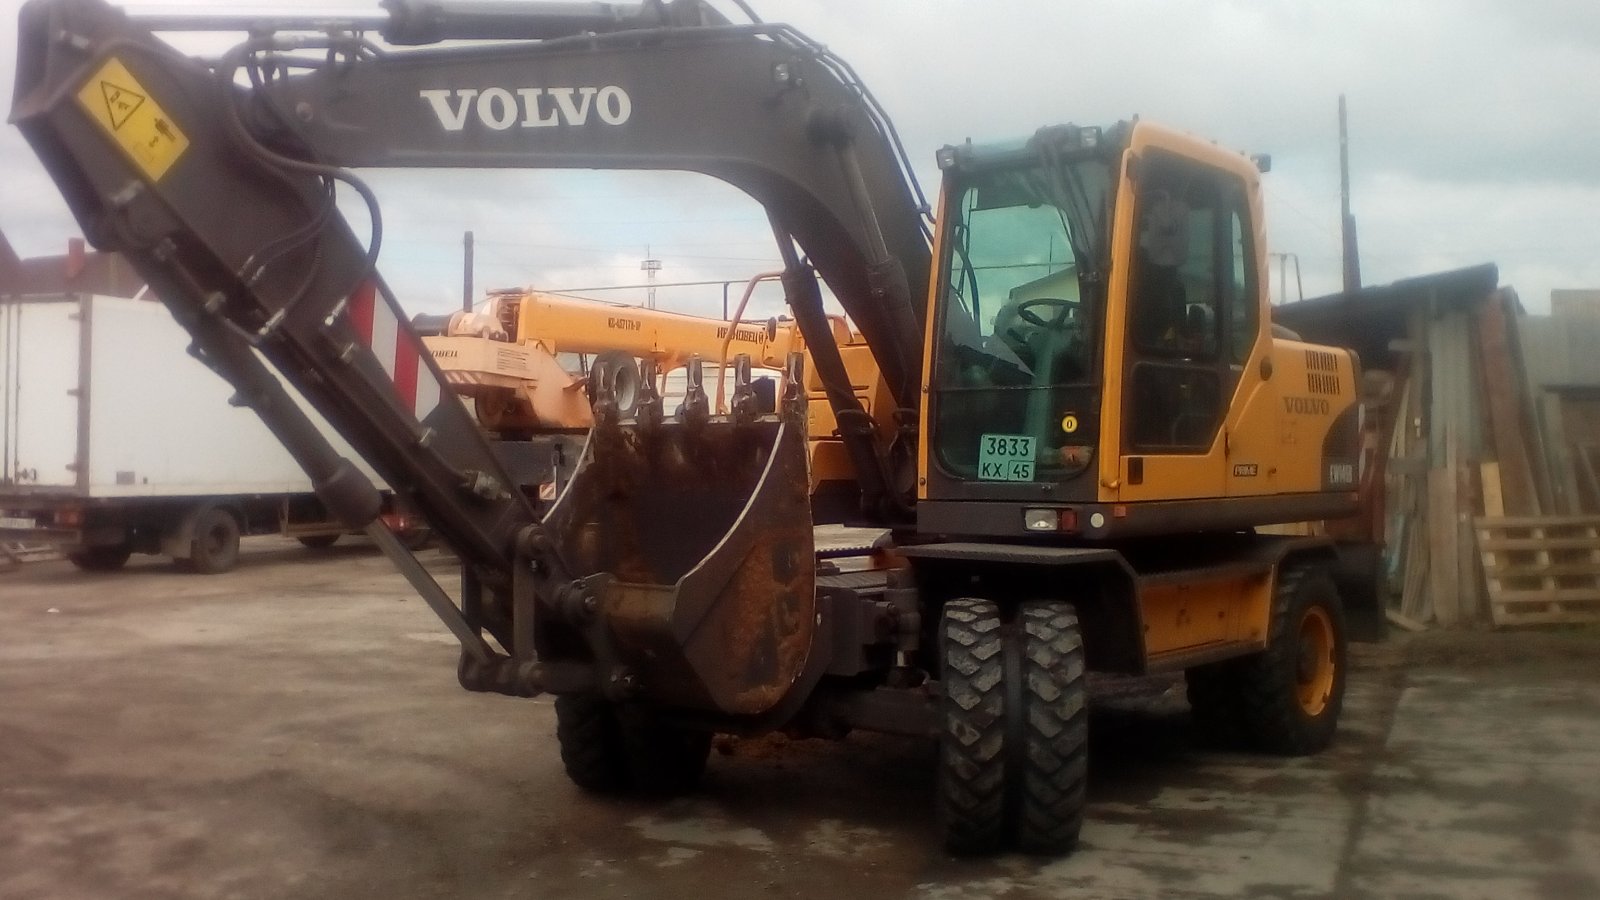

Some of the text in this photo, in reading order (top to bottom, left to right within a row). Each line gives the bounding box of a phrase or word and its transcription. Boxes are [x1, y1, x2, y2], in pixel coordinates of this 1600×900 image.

[419, 85, 632, 131] VOLVO
[716, 326, 758, 344] ИВНОВЕЦ
[1282, 396, 1329, 415] VOLVO
[986, 437, 1030, 457] 3833
[1012, 464, 1030, 479] 45
[1235, 465, 1257, 475] PRIME
